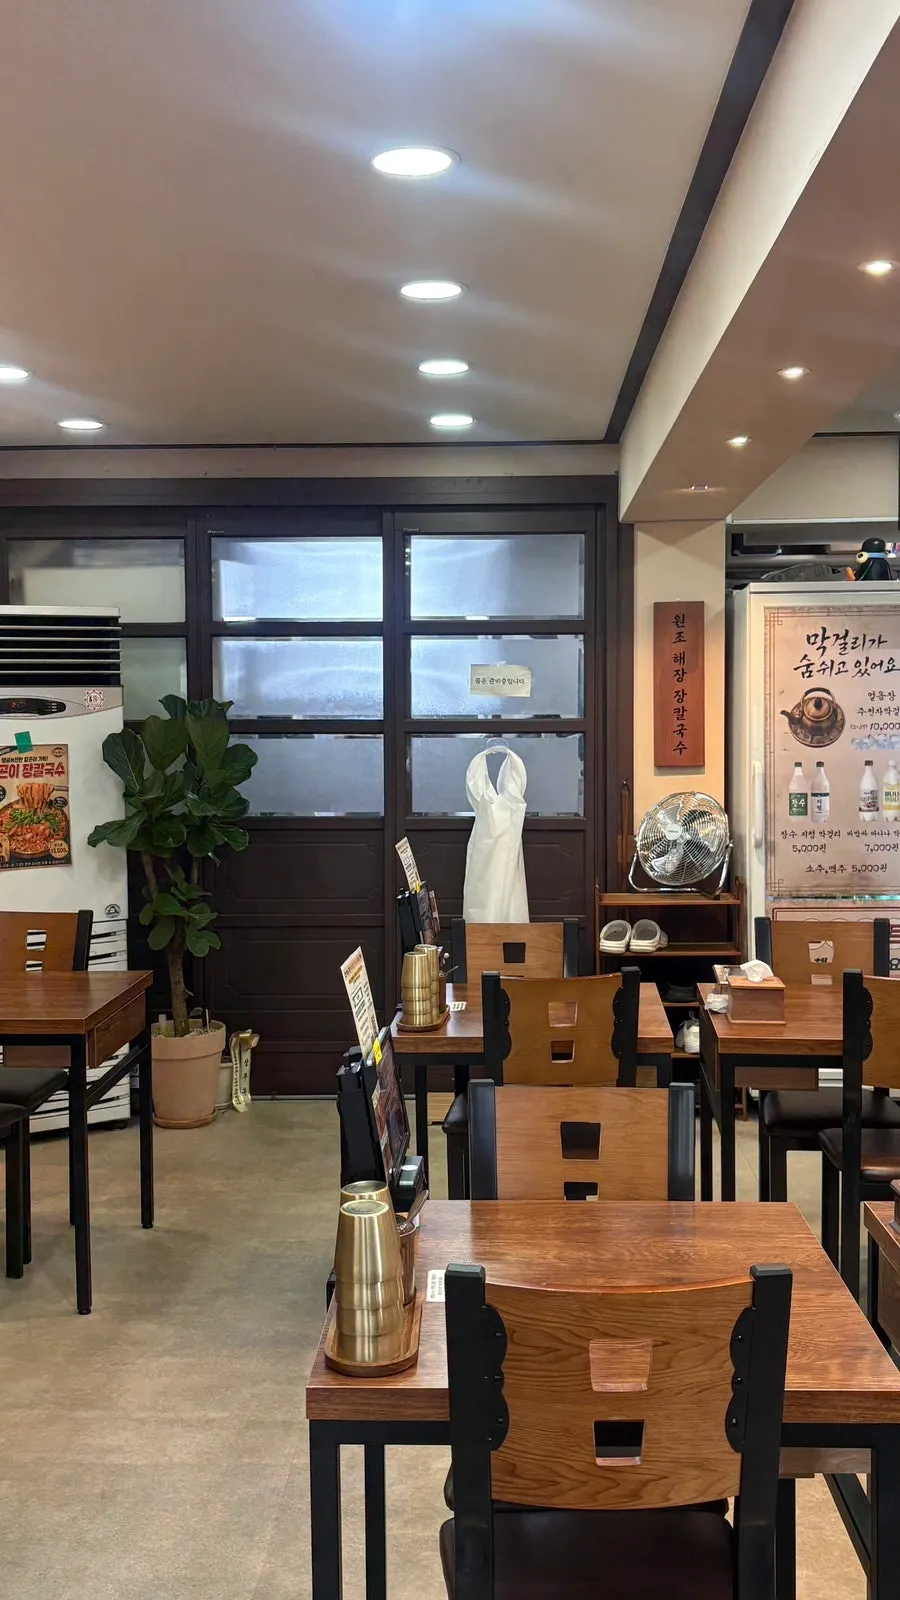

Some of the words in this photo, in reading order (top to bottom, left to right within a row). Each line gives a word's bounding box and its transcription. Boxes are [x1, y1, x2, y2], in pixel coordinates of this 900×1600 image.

[672, 613, 686, 644] 원조
[806, 626, 888, 658] 막걸리가
[673, 651, 687, 683] 해장
[852, 656, 900, 678] 있어요
[673, 688, 687, 756] 장칼국수
[22, 761, 66, 779] 장칼국수
[791, 798, 806, 808] 장수
[779, 829, 798, 840] 장수
[800, 829, 816, 840] 지평
[818, 829, 841, 840] 막걸리
[792, 843, 827, 853] 5,000원
[864, 843, 899, 854] 7,000원
[851, 863, 888, 873] 5,000원
